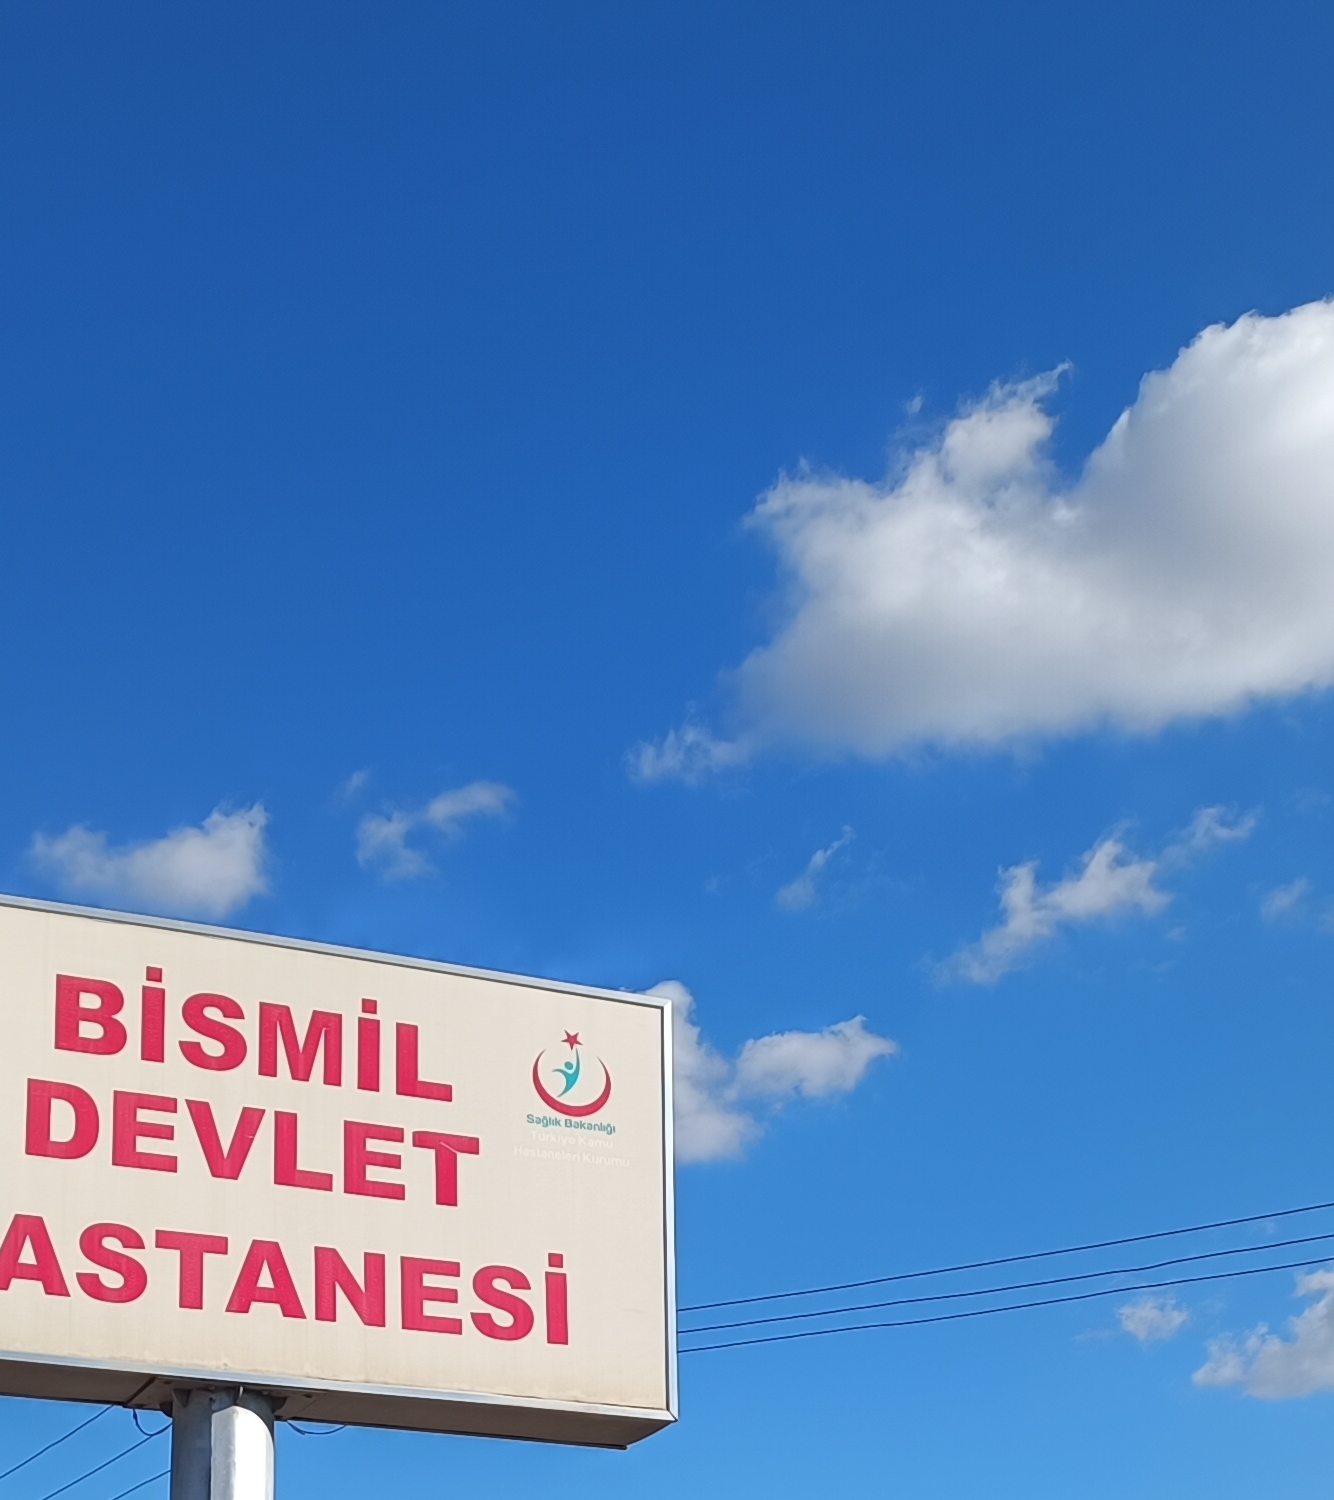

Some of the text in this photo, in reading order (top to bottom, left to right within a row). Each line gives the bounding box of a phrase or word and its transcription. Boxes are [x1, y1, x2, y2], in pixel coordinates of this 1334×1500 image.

[55, 966, 453, 1103] BİSMİL
[26, 1080, 479, 1206] DEVLET
[526, 1113, 616, 1135] Sağlık Bakanlığı
